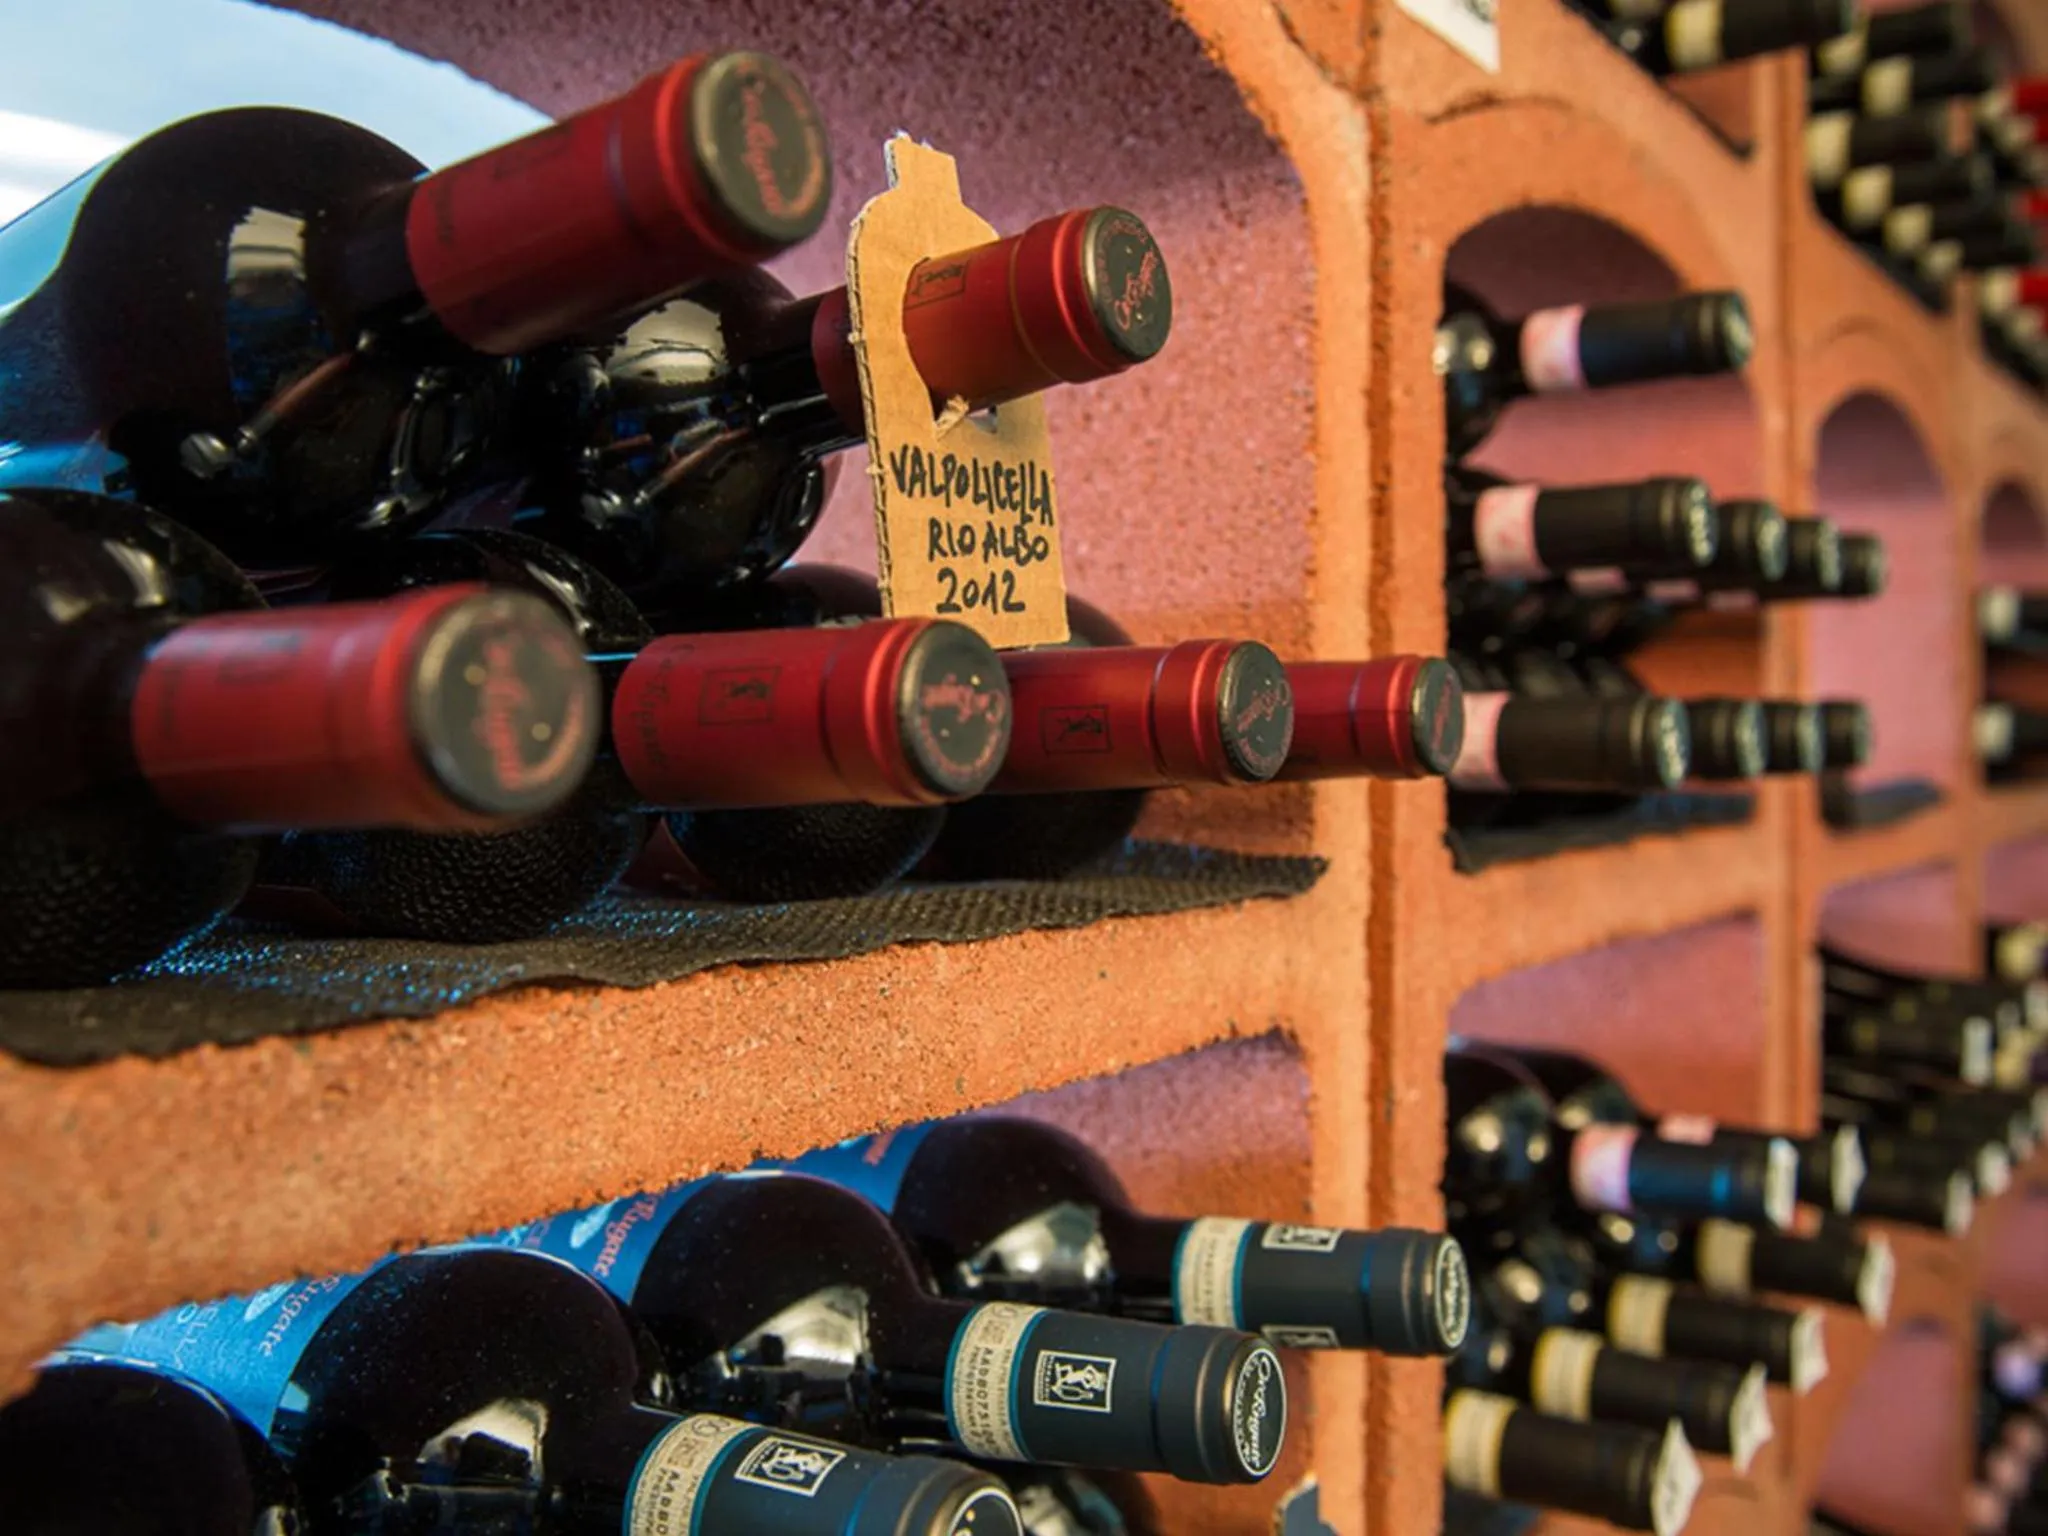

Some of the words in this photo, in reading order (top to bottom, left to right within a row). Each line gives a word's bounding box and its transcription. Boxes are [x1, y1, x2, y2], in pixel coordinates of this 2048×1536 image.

[889, 443, 1054, 527] VALPOLICELLA
[927, 517, 976, 563] RIO
[982, 520, 1050, 567] ALBO
[936, 567, 1026, 615] 2012
